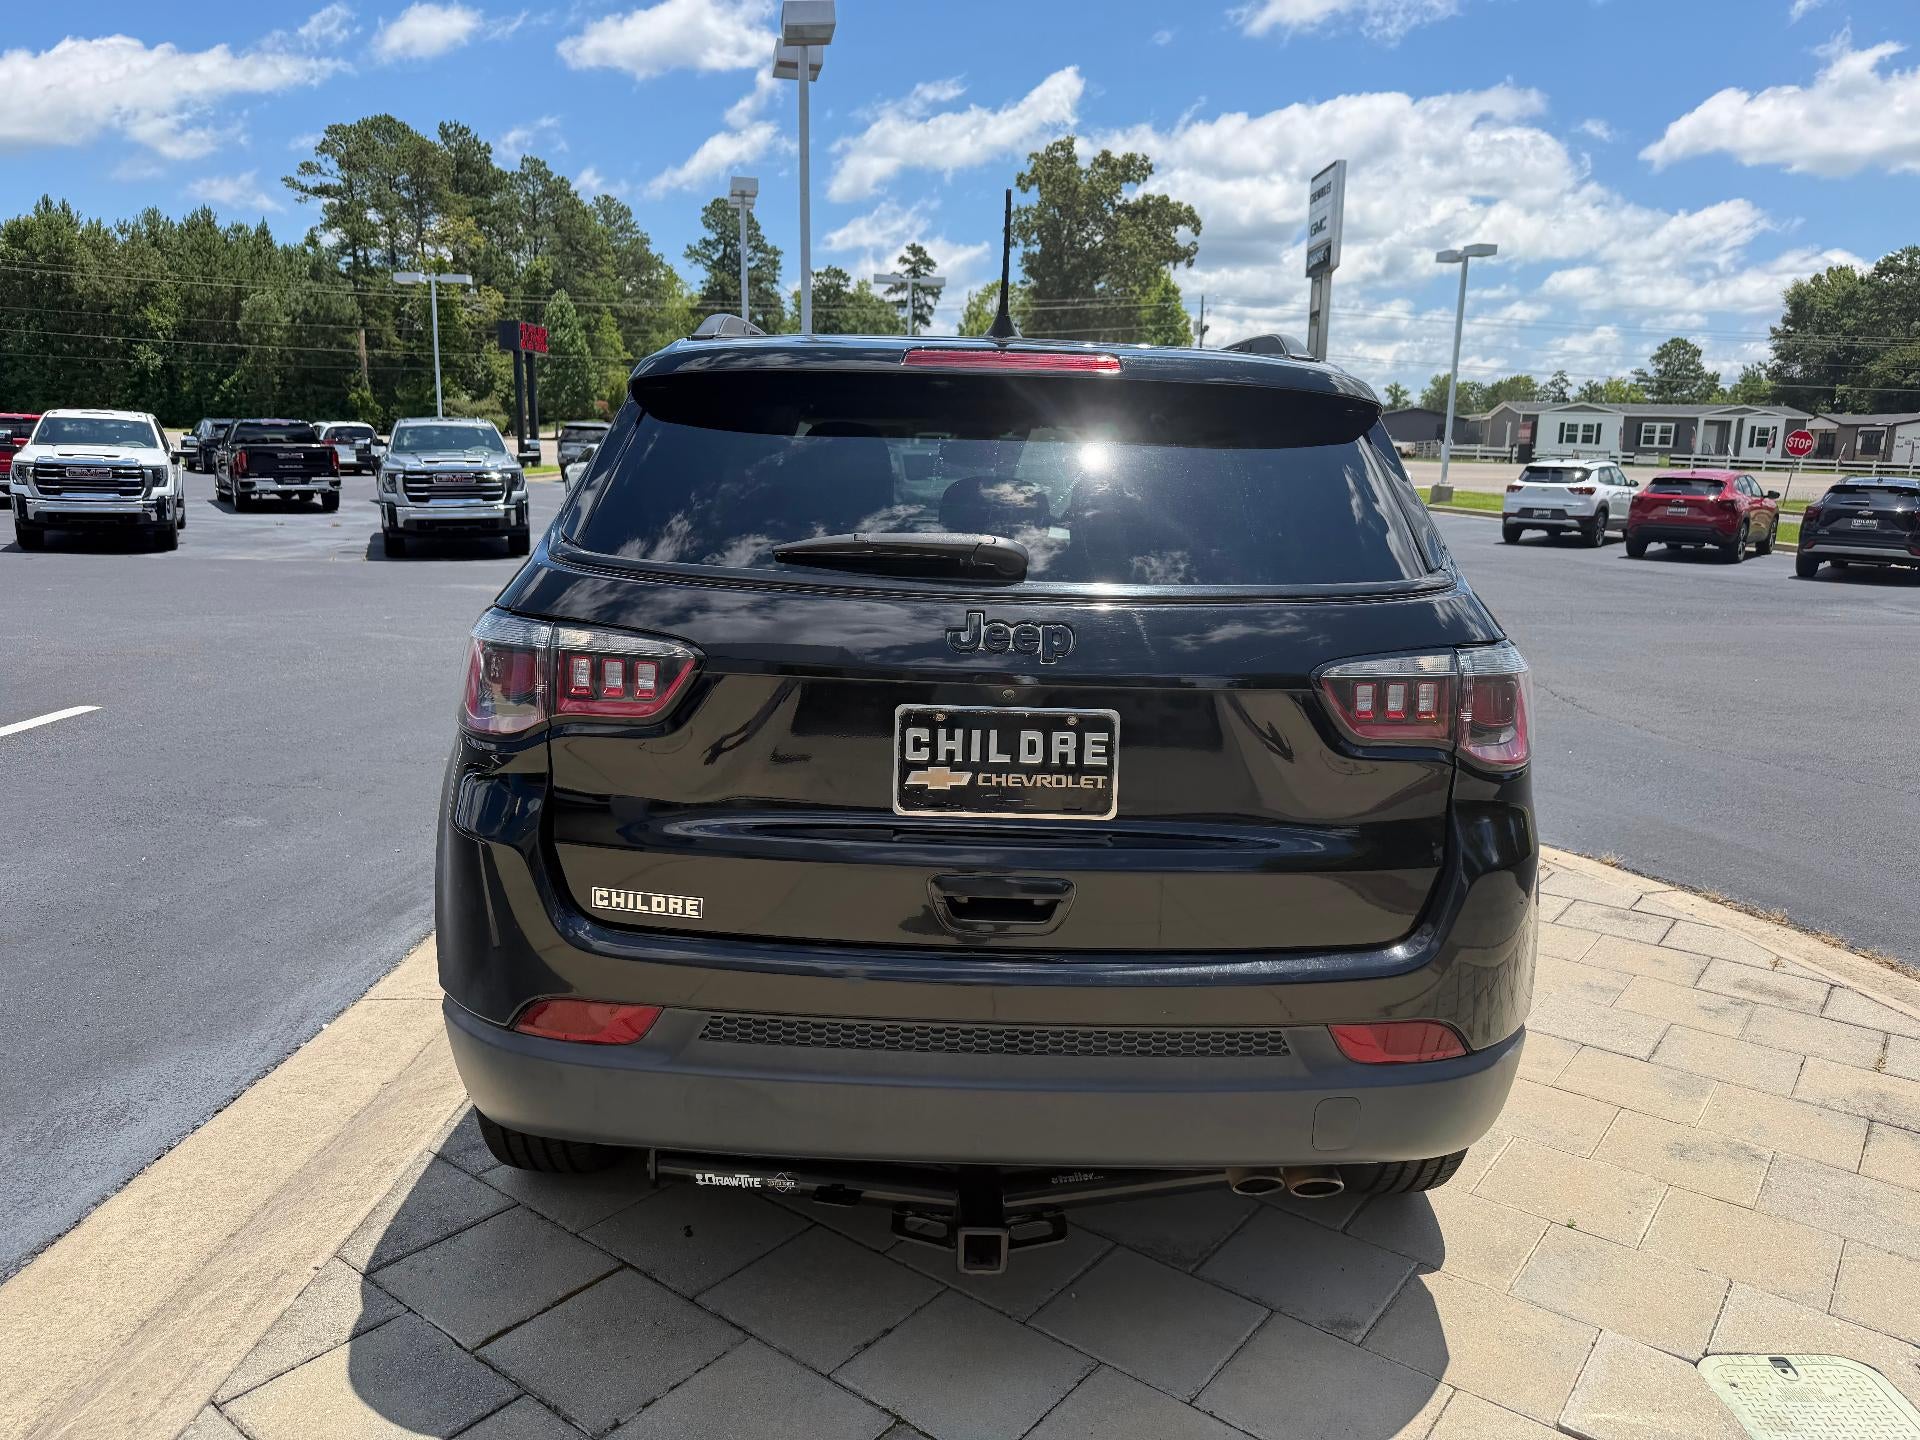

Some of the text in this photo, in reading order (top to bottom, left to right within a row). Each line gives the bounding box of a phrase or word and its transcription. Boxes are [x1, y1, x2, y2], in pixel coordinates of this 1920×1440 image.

[1310, 216, 1327, 237] GMC
[1787, 437, 1812, 449] STOP
[67, 467, 112, 478] GMC
[434, 473, 476, 484] GMC
[945, 610, 1076, 664] Jeep
[905, 728, 1109, 765] CHILDRE
[977, 772, 1109, 789] CHEVROLET
[595, 890, 699, 916] CHILDRE
[1796, 1355, 1838, 1363] HERE
